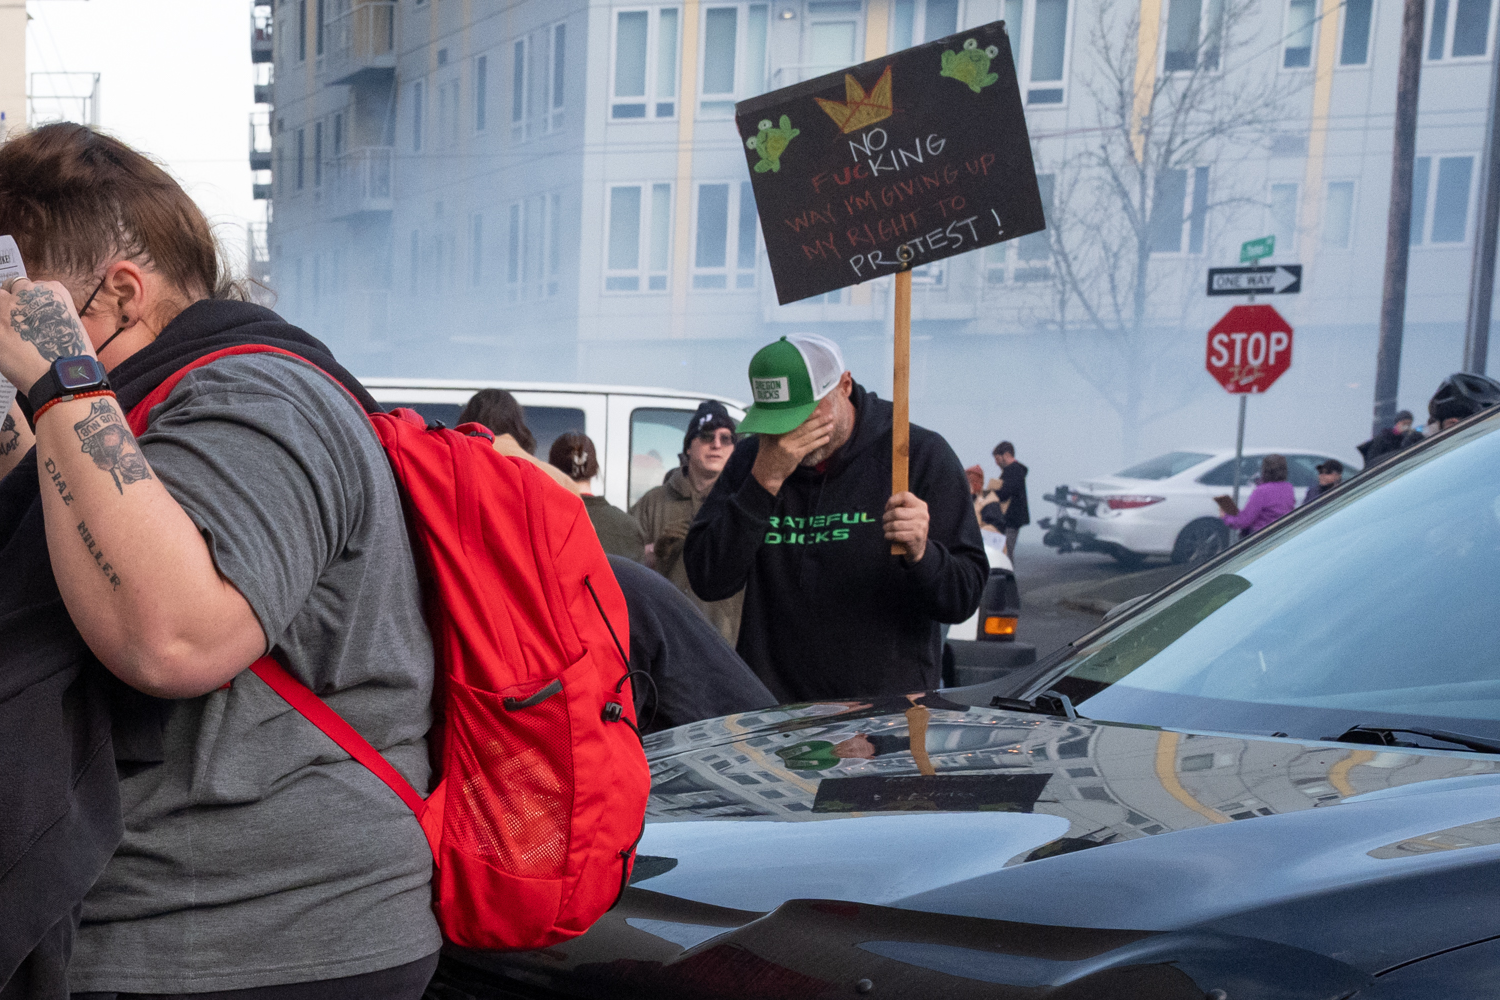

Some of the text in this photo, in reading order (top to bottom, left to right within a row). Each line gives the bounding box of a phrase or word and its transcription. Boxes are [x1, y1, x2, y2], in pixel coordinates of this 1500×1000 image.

[849, 128, 887, 162] NO
[868, 133, 946, 177] KING
[784, 153, 995, 232] WAY I'M GIVING UP
[802, 195, 966, 260] MY RIGHT TO
[849, 215, 979, 277] PROTEST
[1216, 272, 1273, 288] ONE WAY
[1210, 331, 1289, 368] STOP
[755, 380, 782, 390] OREGON
[757, 390, 780, 400] DUCKS
[764, 528, 850, 545] DUCKS
[769, 511, 876, 529] RATEFUL
